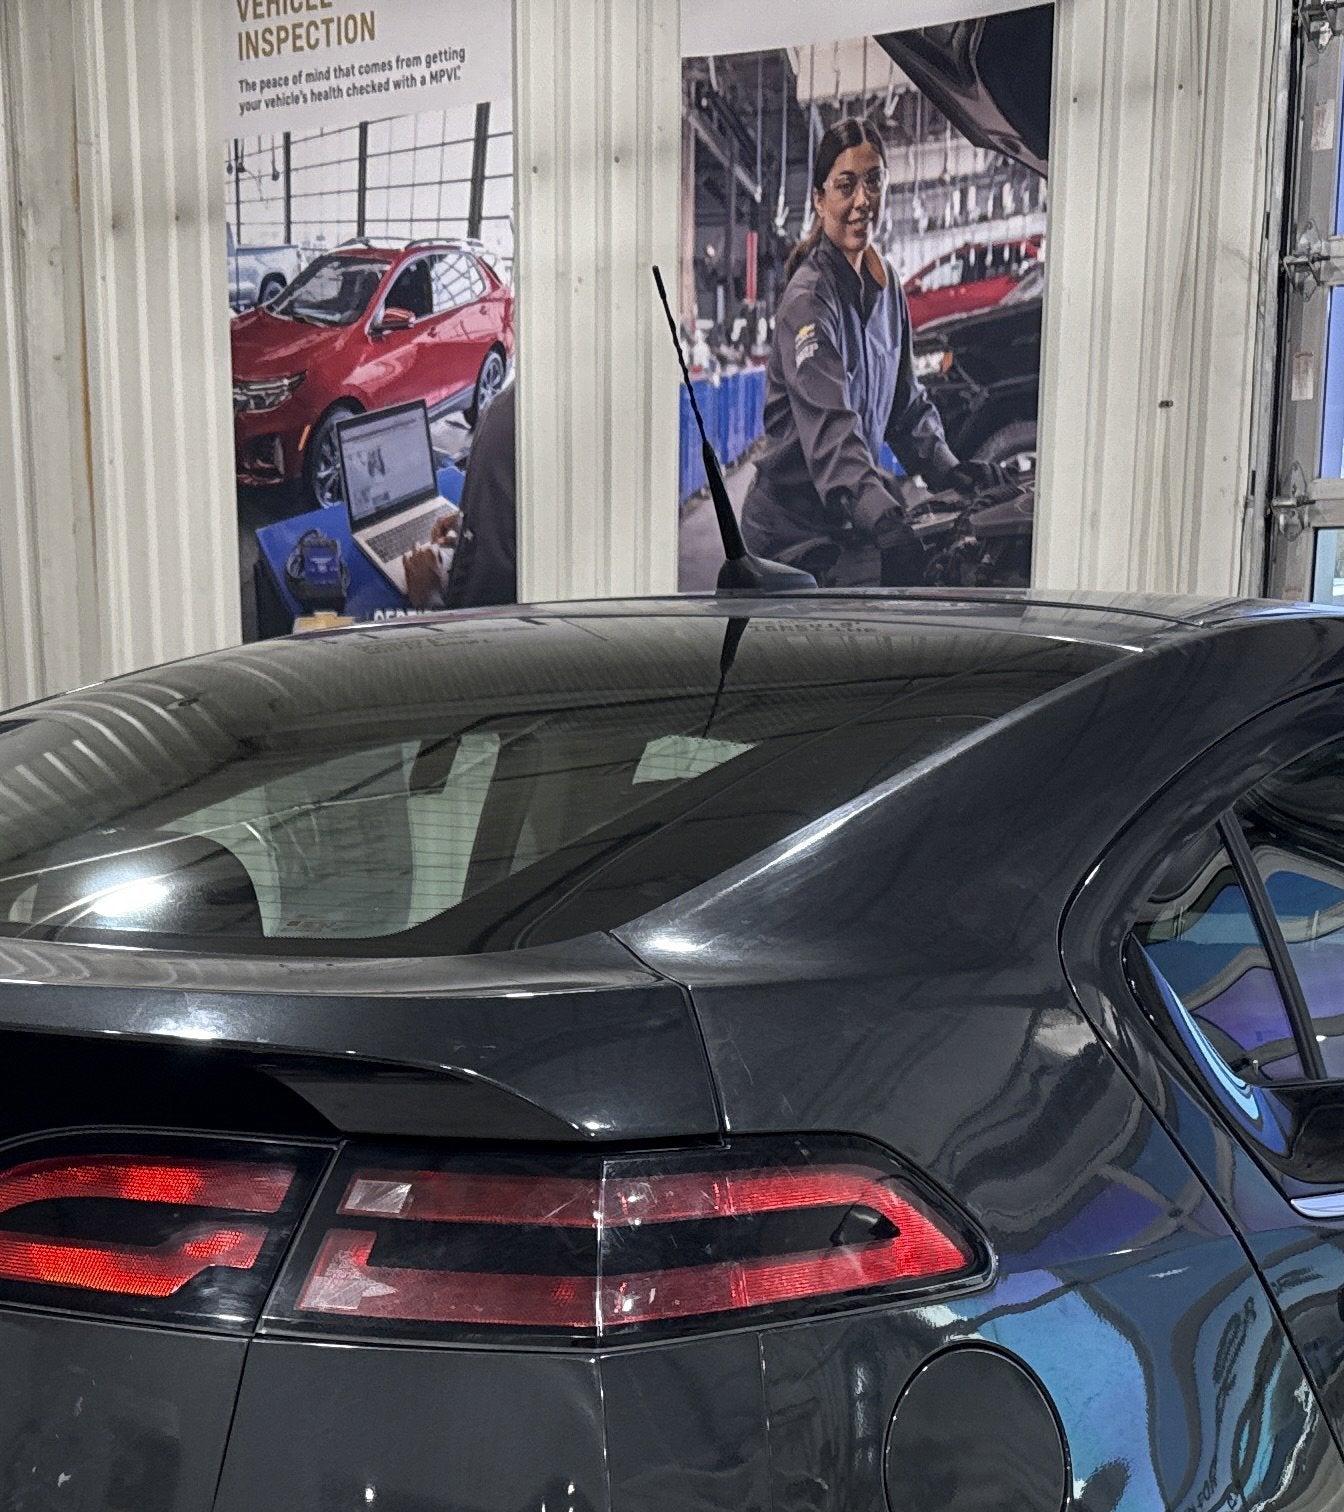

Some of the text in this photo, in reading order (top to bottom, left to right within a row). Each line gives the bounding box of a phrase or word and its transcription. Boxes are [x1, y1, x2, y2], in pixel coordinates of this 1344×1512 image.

[237, 11, 376, 61] INSPECTION
[238, 46, 466, 94] The peace of mind that comes from getting
[238, 99, 262, 116] your
[264, 89, 308, 109] vehicle's
[310, 85, 344, 102] health
[346, 77, 390, 98] checked
[392, 73, 418, 90] with
[420, 75, 427, 86] a
